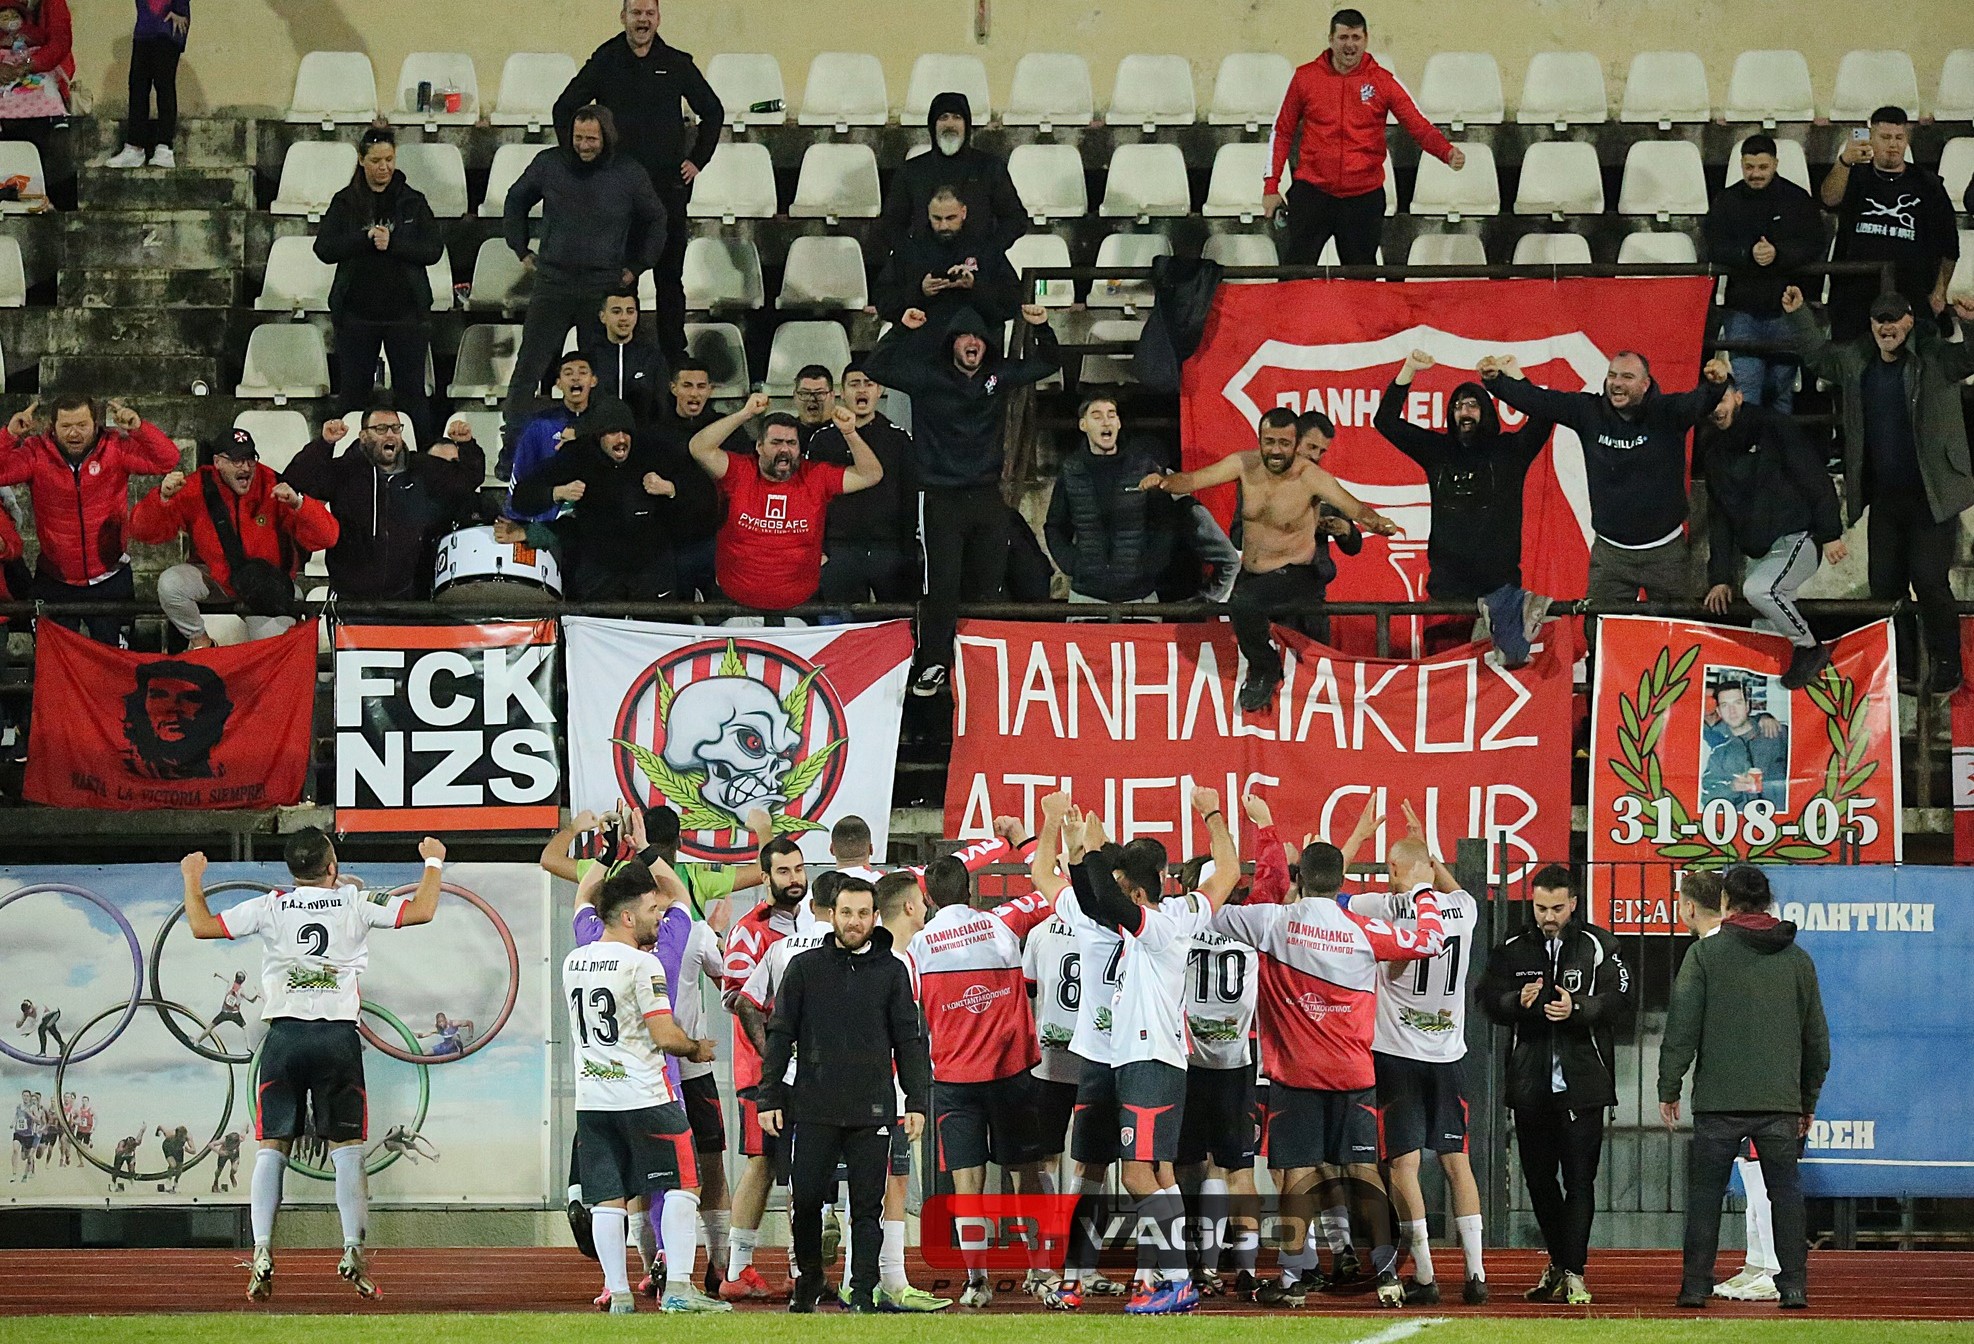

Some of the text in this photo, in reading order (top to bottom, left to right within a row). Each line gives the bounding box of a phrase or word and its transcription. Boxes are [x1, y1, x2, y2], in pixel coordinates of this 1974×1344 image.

[740, 512, 808, 530] PYRGOS AFC
[336, 646, 558, 727] FCK
[336, 728, 559, 808] NZS
[117, 785, 133, 801] LA
[142, 789, 200, 805] VICTORIA
[1610, 796, 1880, 846] 31-08-05
[924, 918, 994, 945] ΠΑΝΗΛΕΙΑΚΟΣ
[1287, 920, 1355, 944] ΠΑΝΗΛΕΙΑΚΟΣ
[1441, 907, 1464, 920] ΡΓΟΣ
[296, 922, 330, 959] 2
[589, 960, 619, 973] ΠΥΡΓΟΣ
[1056, 952, 1081, 1012] 8
[1187, 948, 1247, 1004] 10
[1412, 935, 1461, 996] 11
[571, 986, 619, 1049] 13
[1807, 1120, 1875, 1150] ΩΣΗ
